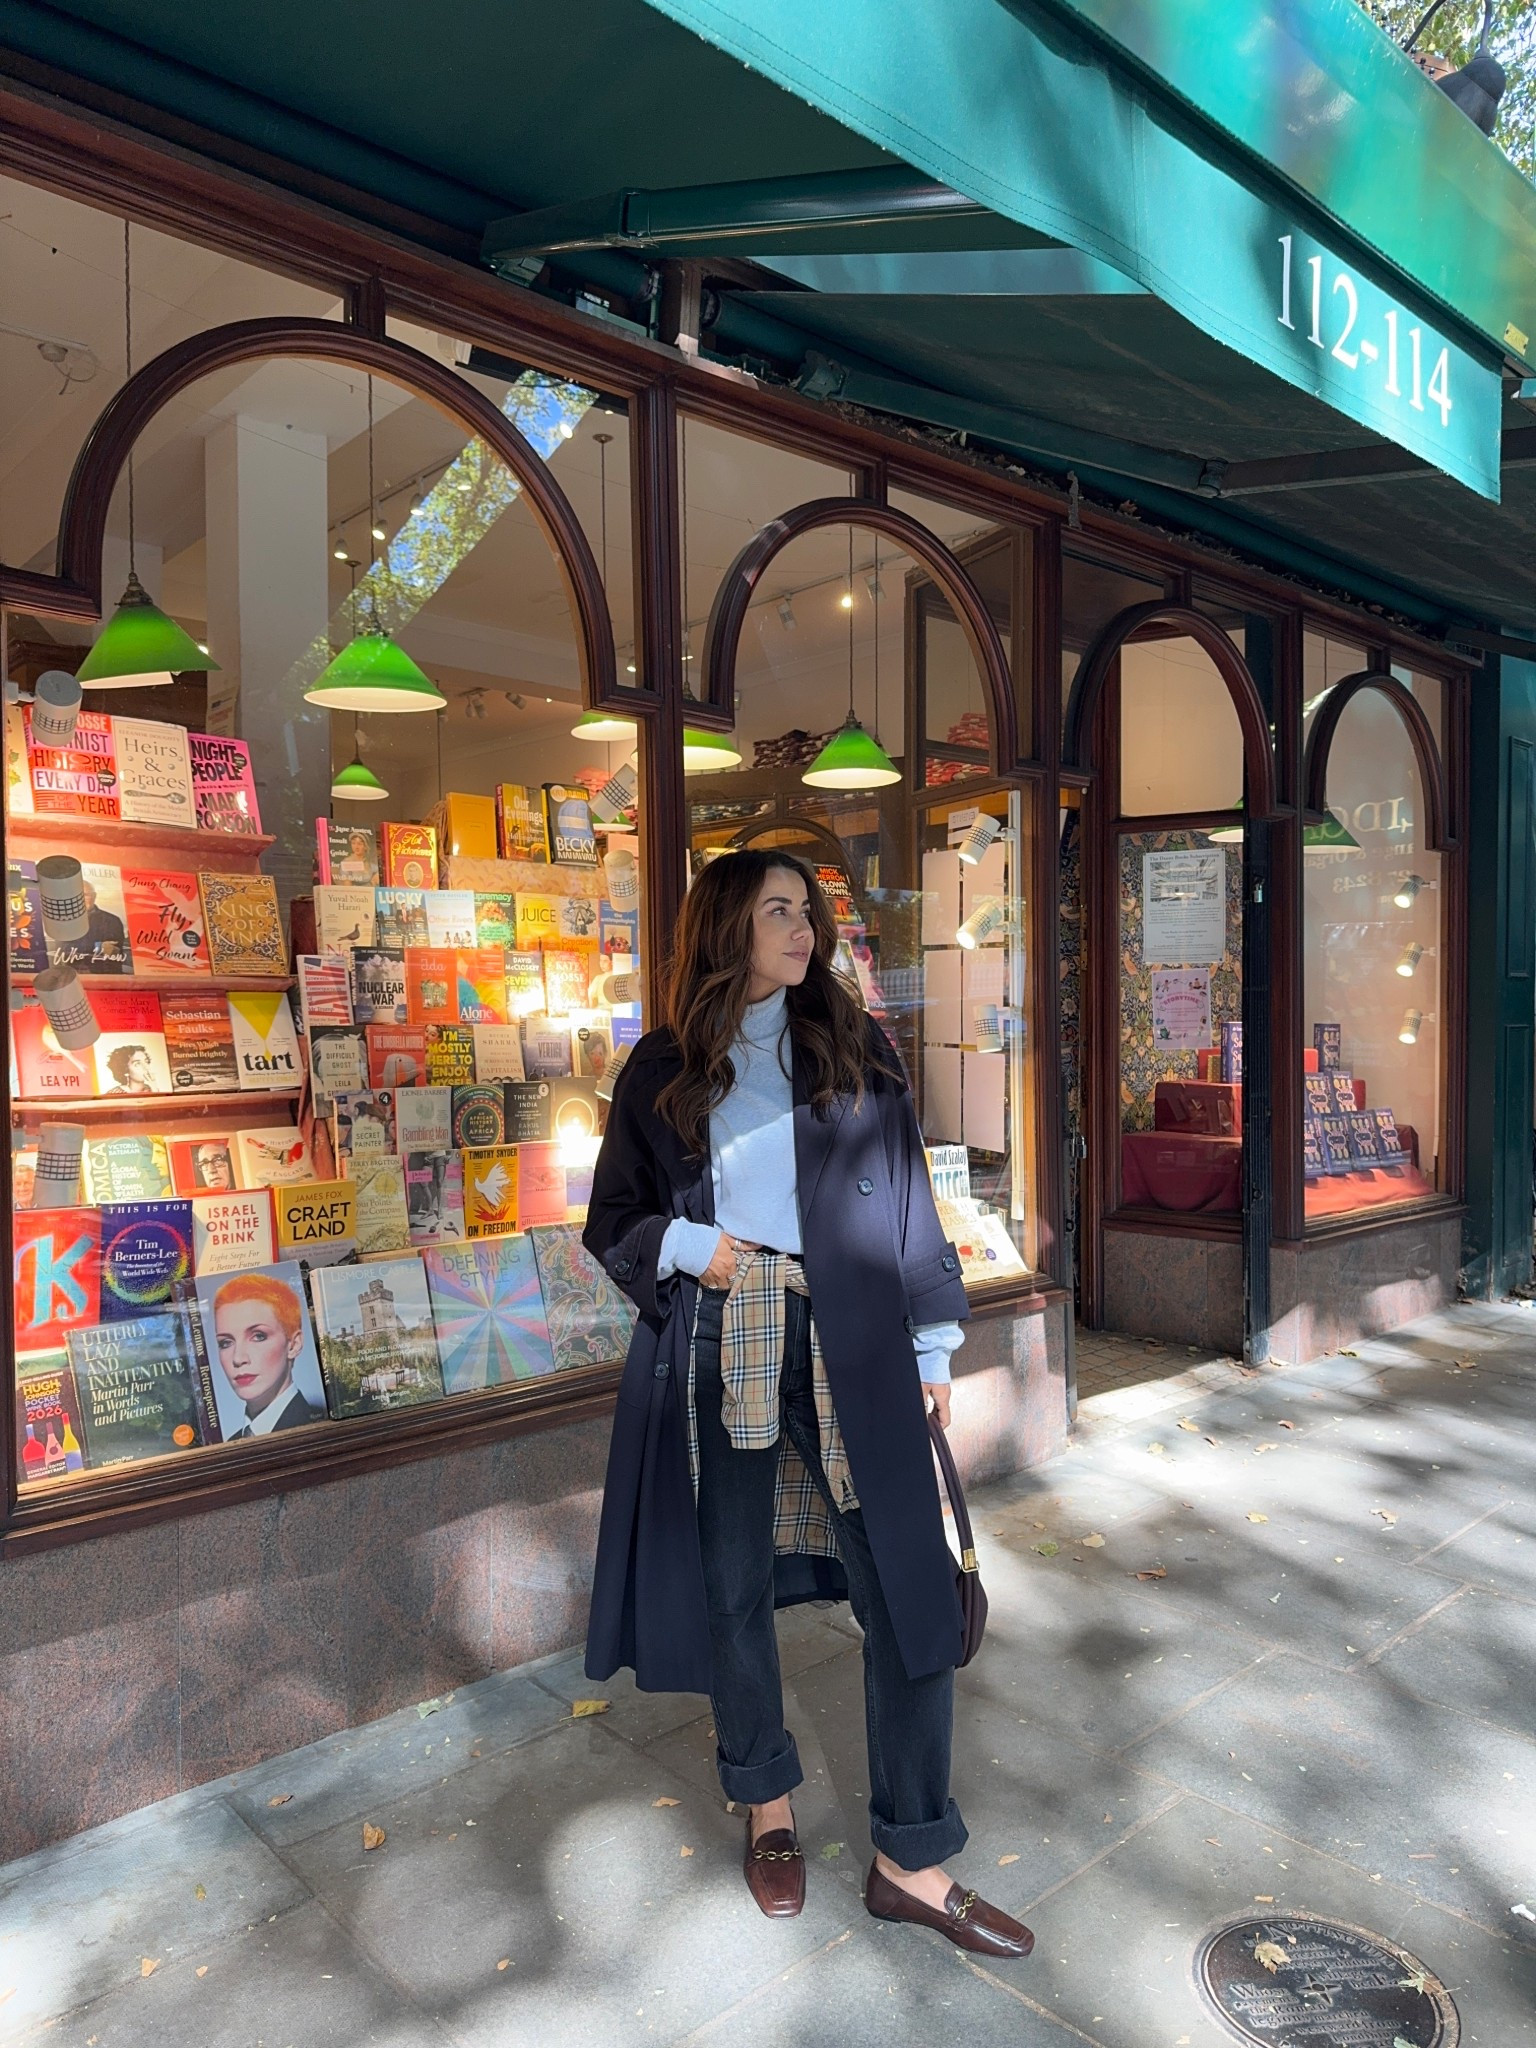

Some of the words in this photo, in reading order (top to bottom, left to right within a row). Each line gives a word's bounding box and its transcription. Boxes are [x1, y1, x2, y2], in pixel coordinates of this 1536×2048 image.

[1278, 235, 1452, 428] 112-114
[125, 738, 178, 757] Heirs
[190, 740, 237, 763] NIGHT
[145, 757, 162, 772] &
[191, 761, 243, 781] PEOPLE
[123, 769, 186, 789] Graces
[77, 795, 117, 815] YEAR
[513, 796, 529, 810] Our
[505, 806, 543, 825] Evenings
[556, 837, 595, 853] BECKY
[129, 877, 156, 890] Jung
[158, 878, 191, 893] Chang
[378, 891, 423, 907] LUCKY
[475, 893, 512, 902] upremacy
[216, 900, 269, 918] KING
[521, 908, 557, 922] JUICE
[235, 920, 258, 930] OF
[136, 930, 171, 945] Wild
[215, 928, 281, 945] KINGS
[53, 947, 88, 965] Who
[91, 947, 127, 963] Knew
[156, 947, 197, 961] Swans
[359, 982, 404, 994] NUCLEAR
[372, 994, 395, 1005] WAR
[166, 1010, 221, 1020] Sebastian
[460, 1006, 493, 1019] Alone
[178, 1024, 215, 1034] Faulks
[443, 1030, 457, 1041] I'M
[197, 1040, 219, 1049] Which
[428, 1042, 470, 1053] MOSTLY
[199, 1051, 228, 1059] Brightly
[243, 1051, 295, 1071] tart
[427, 1055, 457, 1065] HERE
[459, 1055, 473, 1065] TO
[432, 1067, 469, 1078] ENJOY
[40, 1076, 59, 1087] LEA
[62, 1076, 80, 1087] YPI
[356, 1132, 380, 1140] SECRET
[468, 1151, 494, 1159] TIMOTHY
[496, 1148, 517, 1158] SNYDER
[930, 1150, 947, 1167] David
[948, 1149, 967, 1167] Szalay
[91, 1143, 112, 1201] OMICA
[295, 1192, 323, 1202] JAMES
[326, 1190, 343, 1199] FOX
[109, 1206, 139, 1214] THIS
[166, 1203, 188, 1212] FOR
[208, 1204, 257, 1218] ISRAEL
[287, 1202, 351, 1223] CRAFT
[206, 1220, 229, 1232] ON
[236, 1217, 260, 1229] THE
[293, 1221, 345, 1240] LAND
[467, 1225, 478, 1237] ON
[483, 1221, 516, 1235] FREEDOM
[136, 1239, 158, 1249] Tim
[212, 1231, 255, 1245] BRINK
[115, 1249, 178, 1262] Berners-Lee
[443, 1249, 520, 1272] DEFINING
[331, 1269, 376, 1282] LISMORE
[460, 1269, 512, 1288] STYLE
[187, 1296, 198, 1321] Annie
[81, 1323, 148, 1347] UTTERLY
[192, 1322, 204, 1356] Lennox
[84, 1343, 121, 1362] LAZY
[87, 1358, 120, 1376] AND
[88, 1359, 185, 1391] INATTENTIVE
[23, 1379, 59, 1396] HUGH
[91, 1385, 129, 1403] Martin
[130, 1380, 155, 1394] Parr
[25, 1394, 59, 1407] POCKET
[200, 1365, 219, 1428] Retrospective
[93, 1403, 105, 1414] in
[107, 1396, 140, 1411] Words
[27, 1407, 62, 1421] 2026
[94, 1413, 118, 1427] and
[119, 1403, 164, 1421] Pictures
[1250, 2014, 1310, 2028] legions
